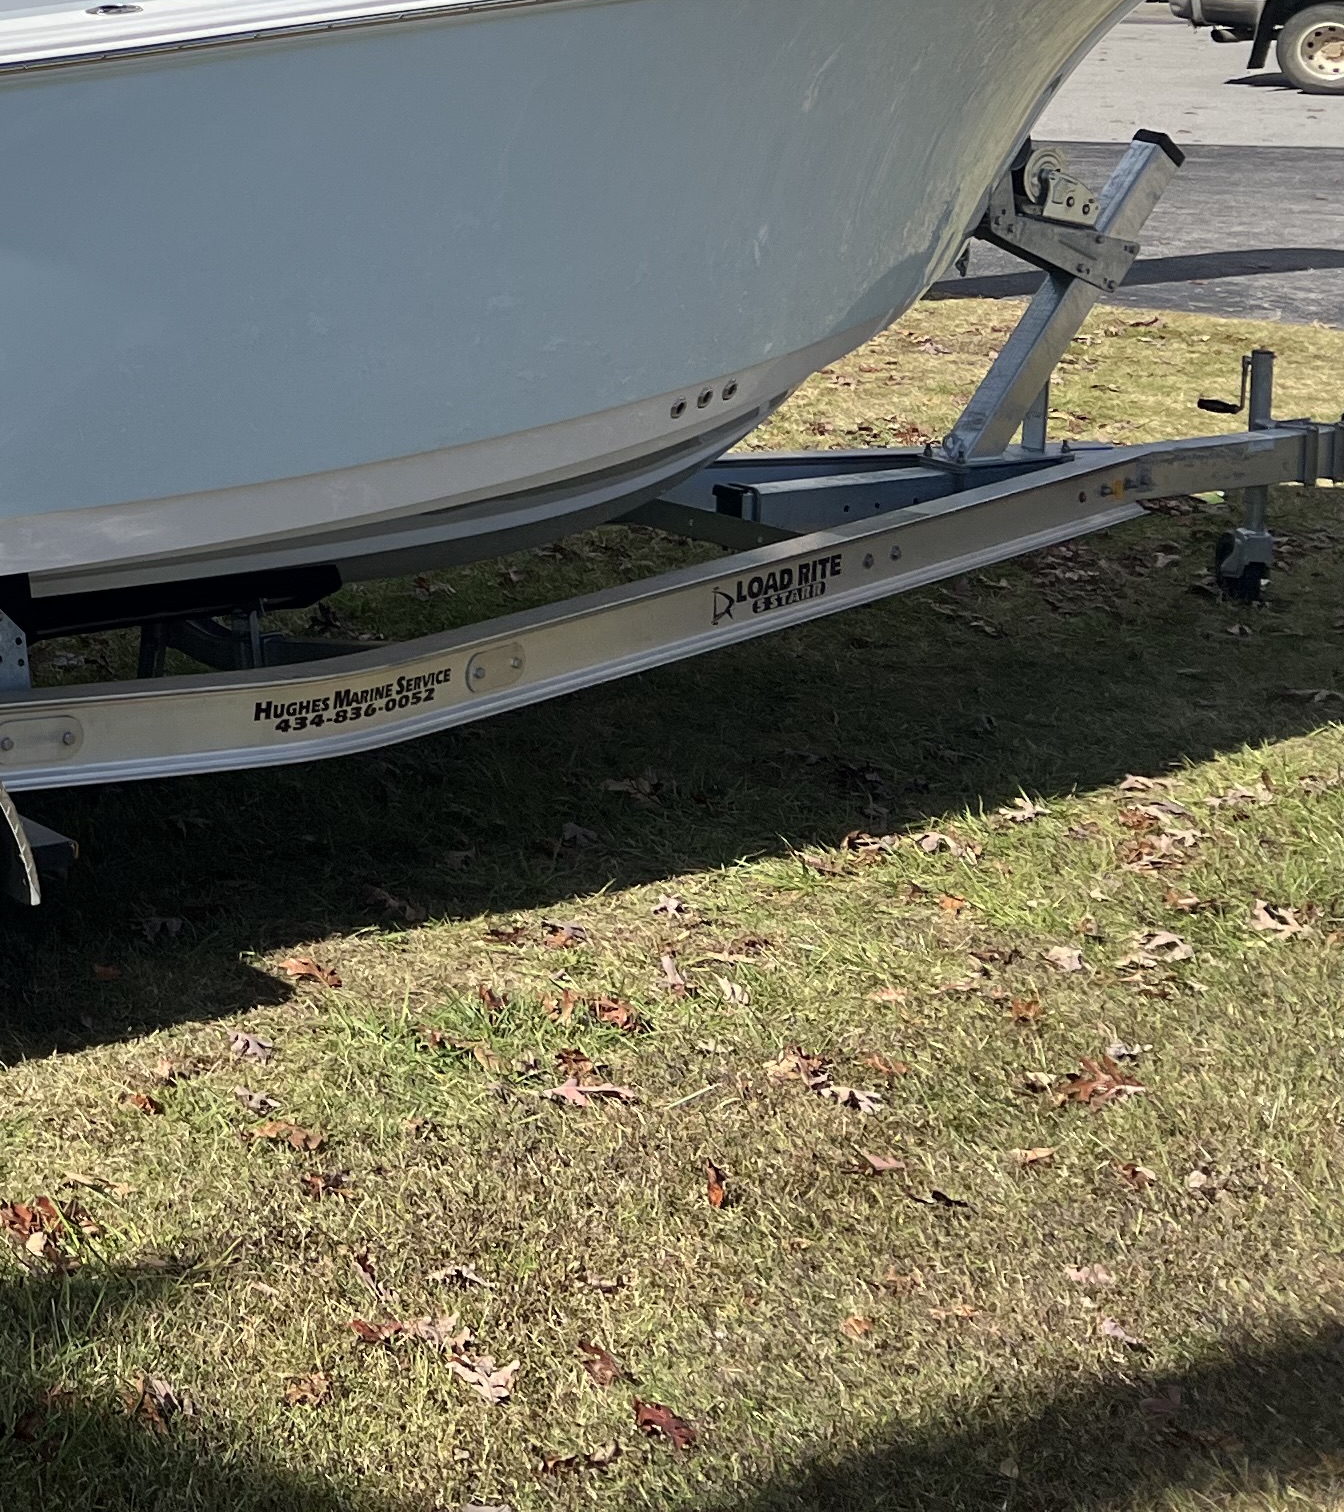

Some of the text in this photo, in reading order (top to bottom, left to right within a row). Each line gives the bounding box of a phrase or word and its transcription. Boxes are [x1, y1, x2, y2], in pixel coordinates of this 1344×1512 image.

[736, 553, 842, 603] LOAD RITE
[275, 687, 436, 733] 434-836-0052
